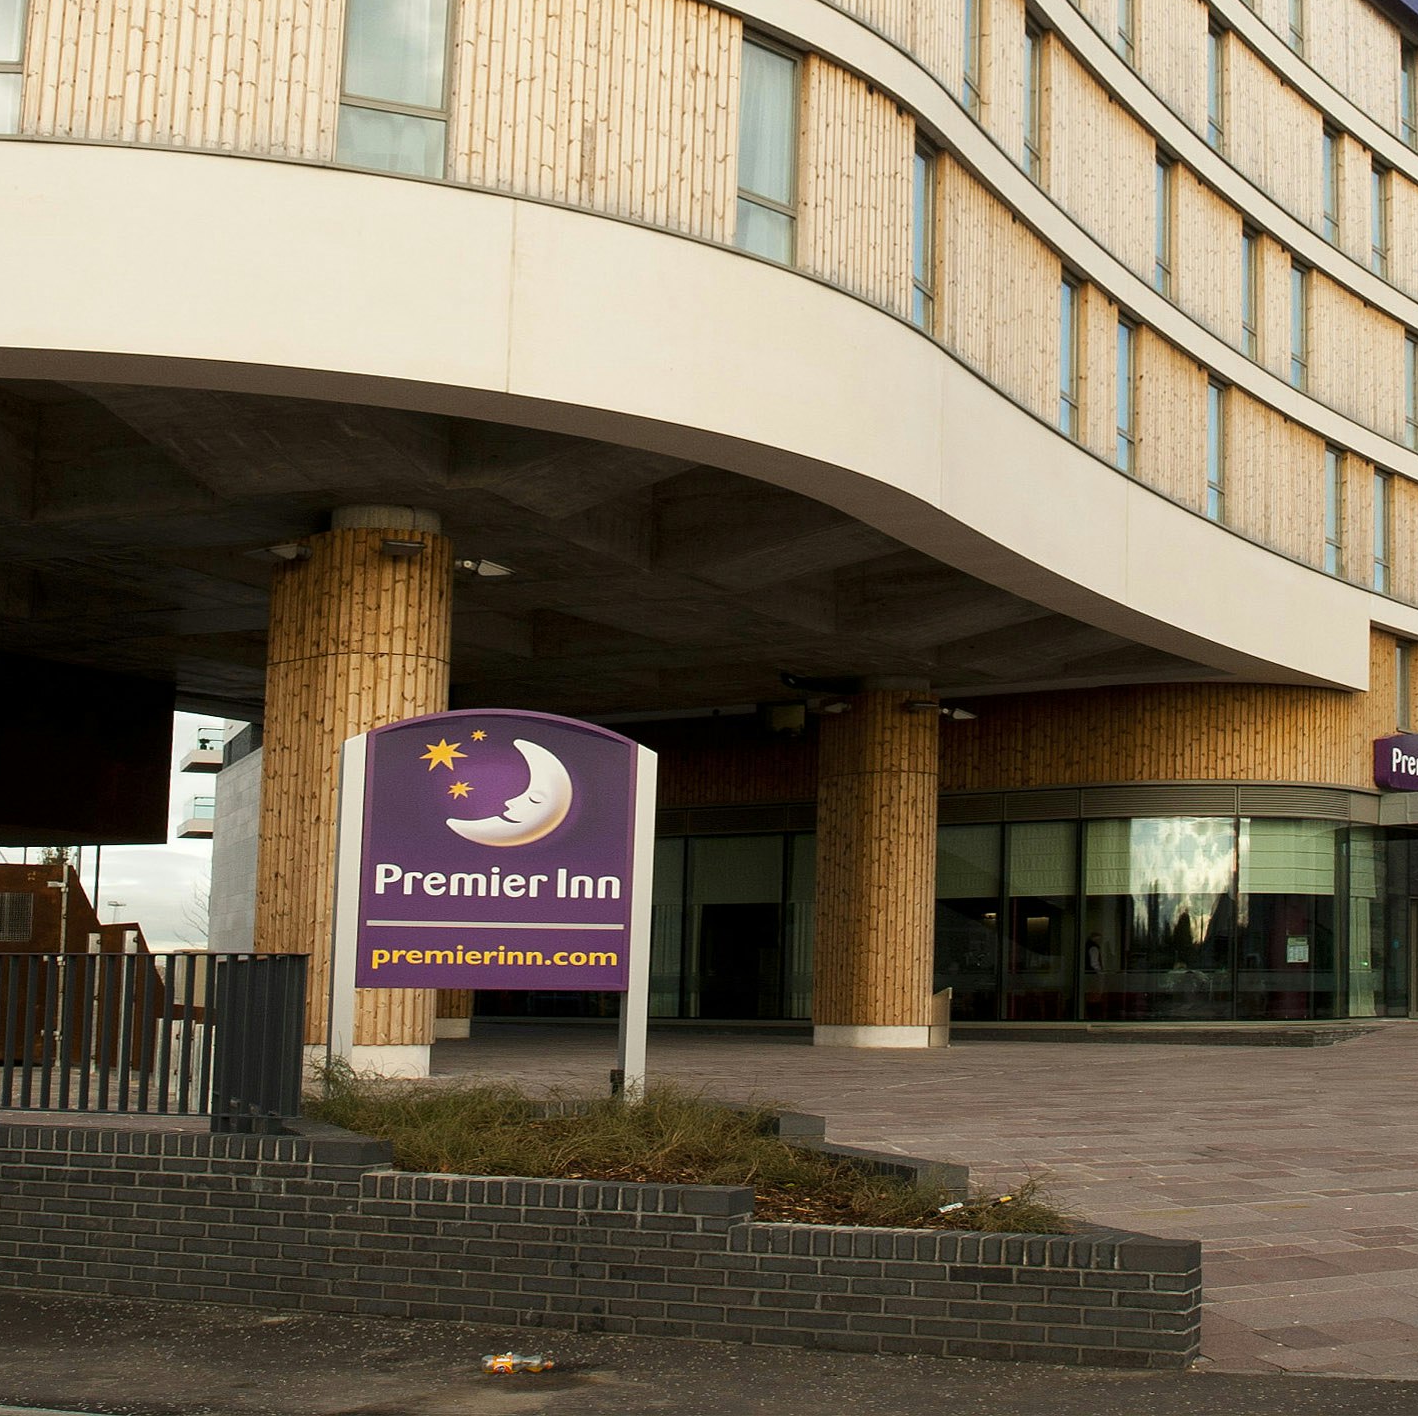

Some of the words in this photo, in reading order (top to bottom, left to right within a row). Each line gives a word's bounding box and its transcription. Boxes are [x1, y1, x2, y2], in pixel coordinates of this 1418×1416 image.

[375, 863, 549, 898] Premier
[556, 868, 621, 899] Inn
[371, 944, 618, 970] premierinn.com
